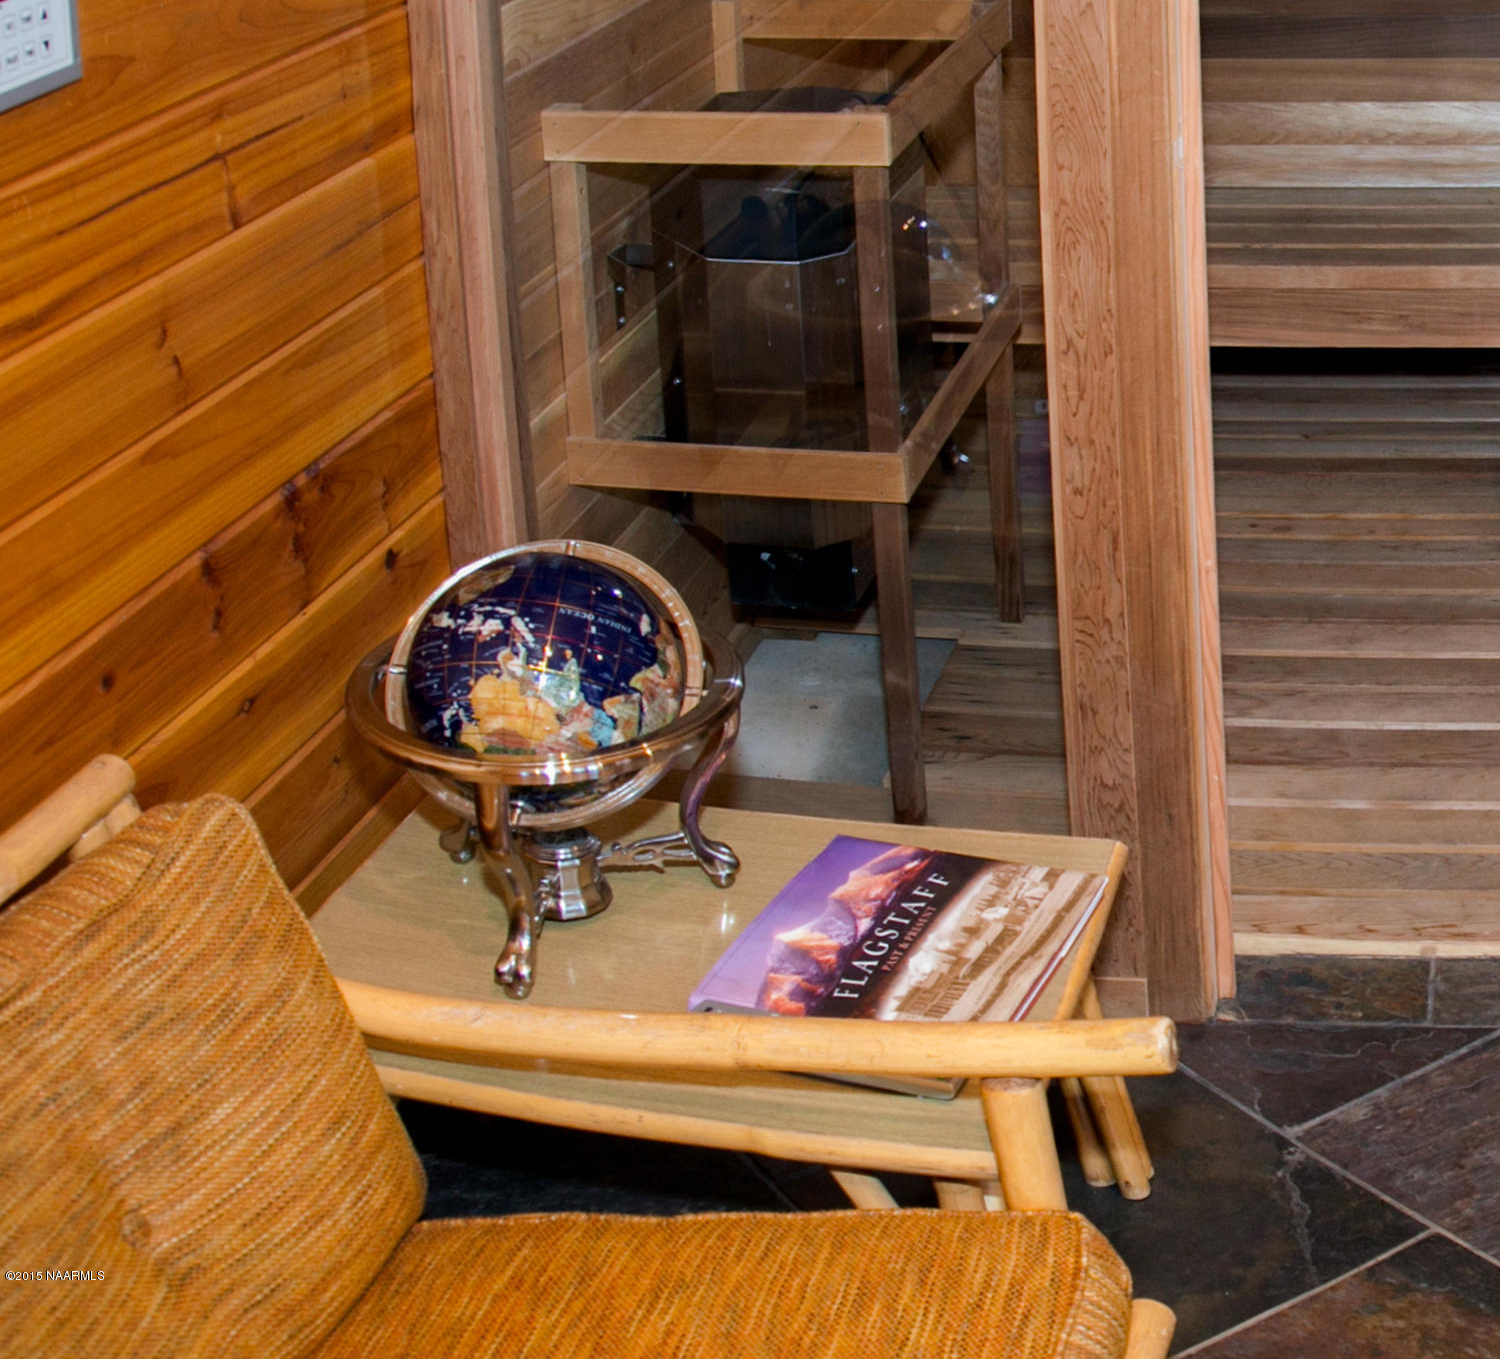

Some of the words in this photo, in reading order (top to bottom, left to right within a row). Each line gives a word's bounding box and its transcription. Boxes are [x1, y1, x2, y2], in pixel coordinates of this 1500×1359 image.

[559, 608, 595, 621] OCEAN
[597, 617, 632, 634] INDIAN
[833, 872, 949, 998] FLAGSTAFF
[881, 949, 904, 972] PAST
[904, 906, 937, 942] PRESENT
